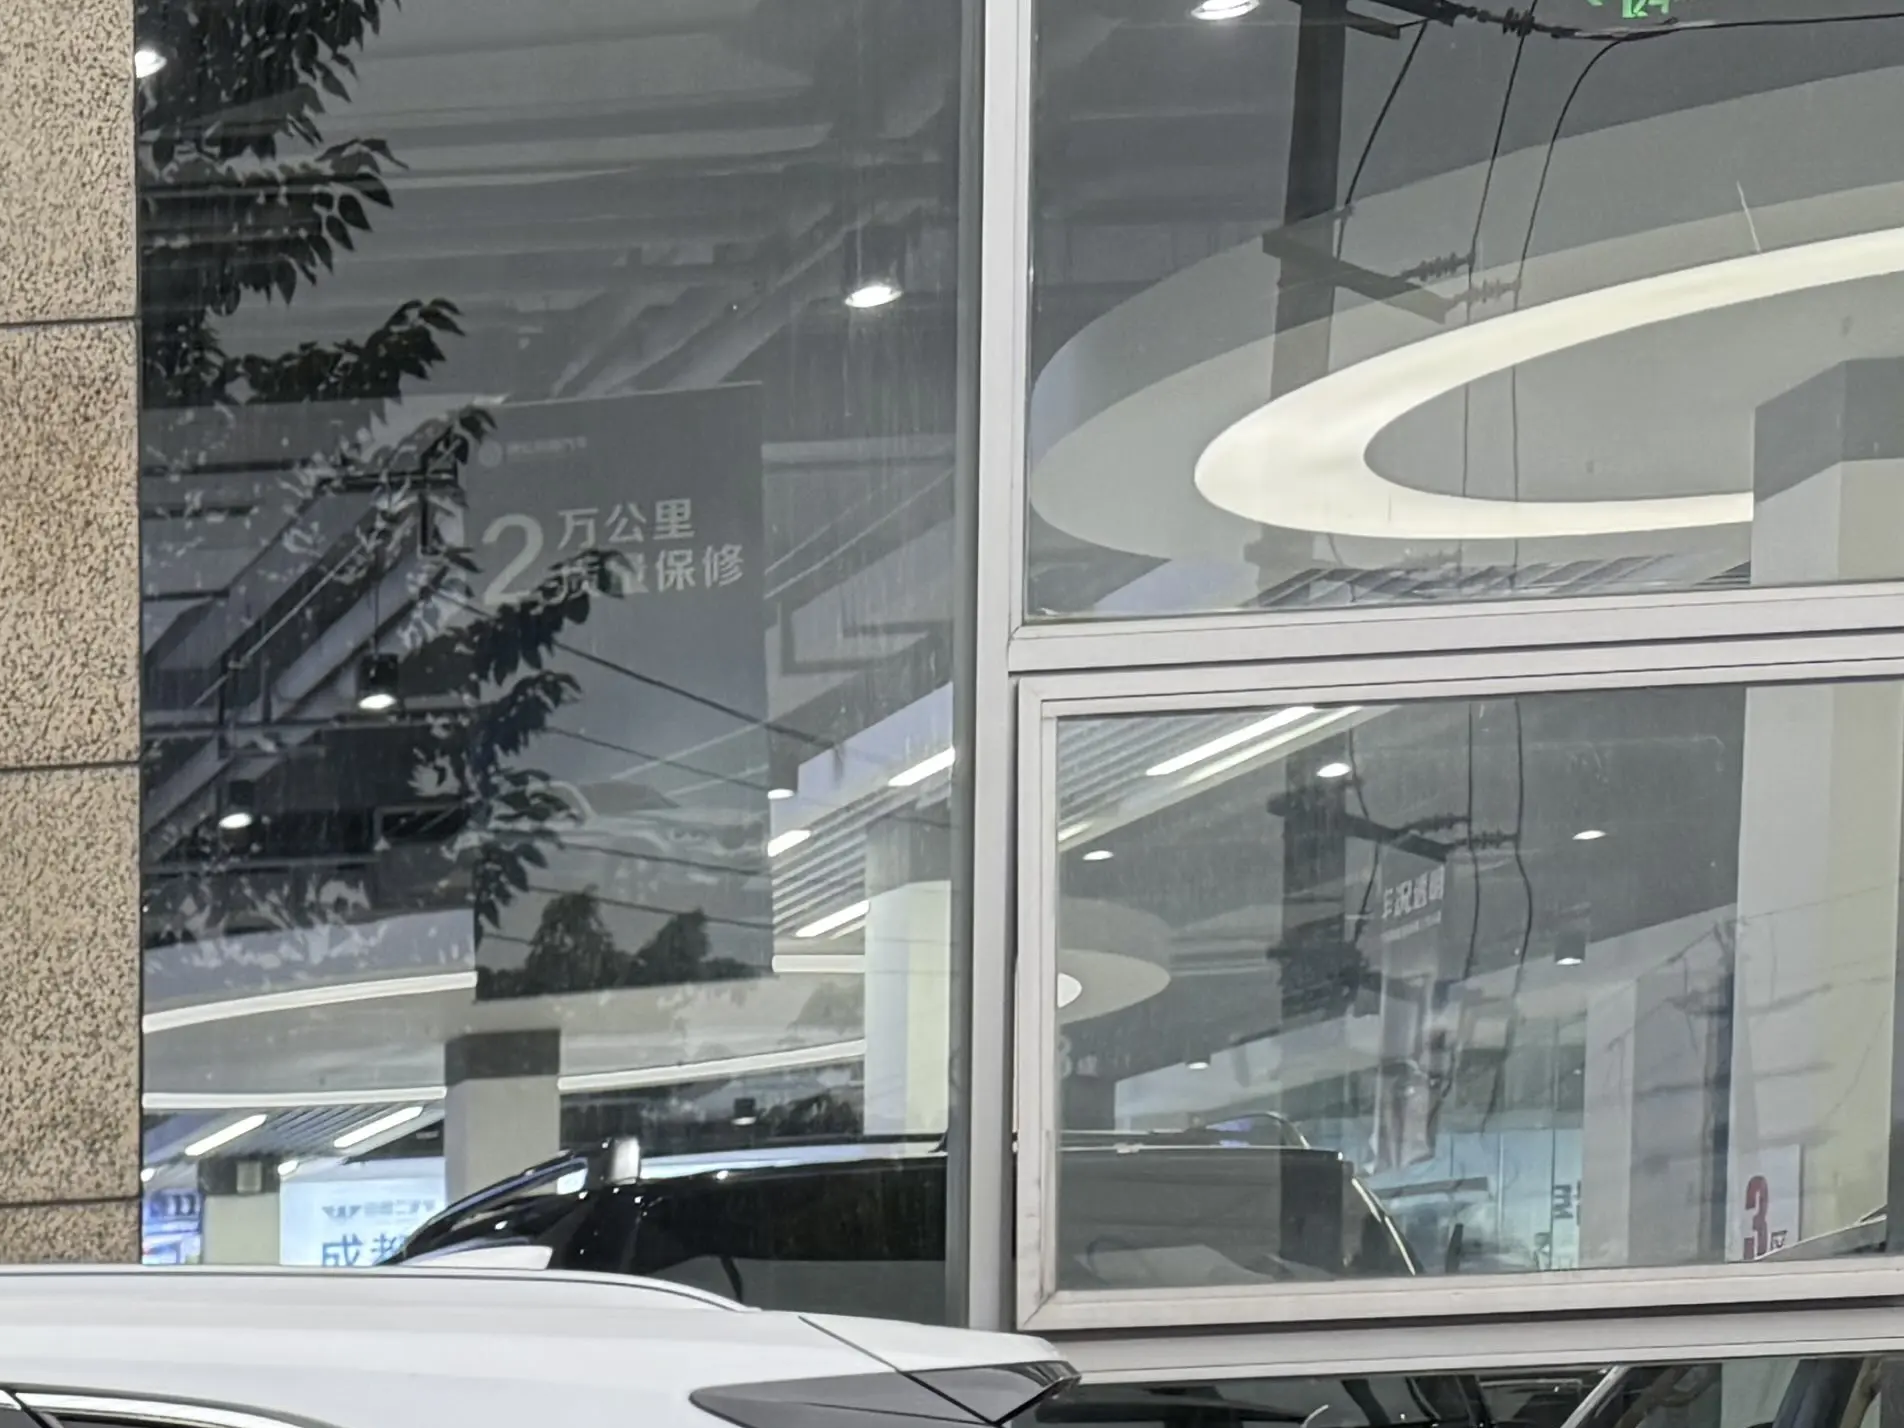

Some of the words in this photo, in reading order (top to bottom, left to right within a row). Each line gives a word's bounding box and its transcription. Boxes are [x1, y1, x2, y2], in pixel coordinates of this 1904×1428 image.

[557, 498, 696, 550] 万公里
[482, 514, 544, 607] 2
